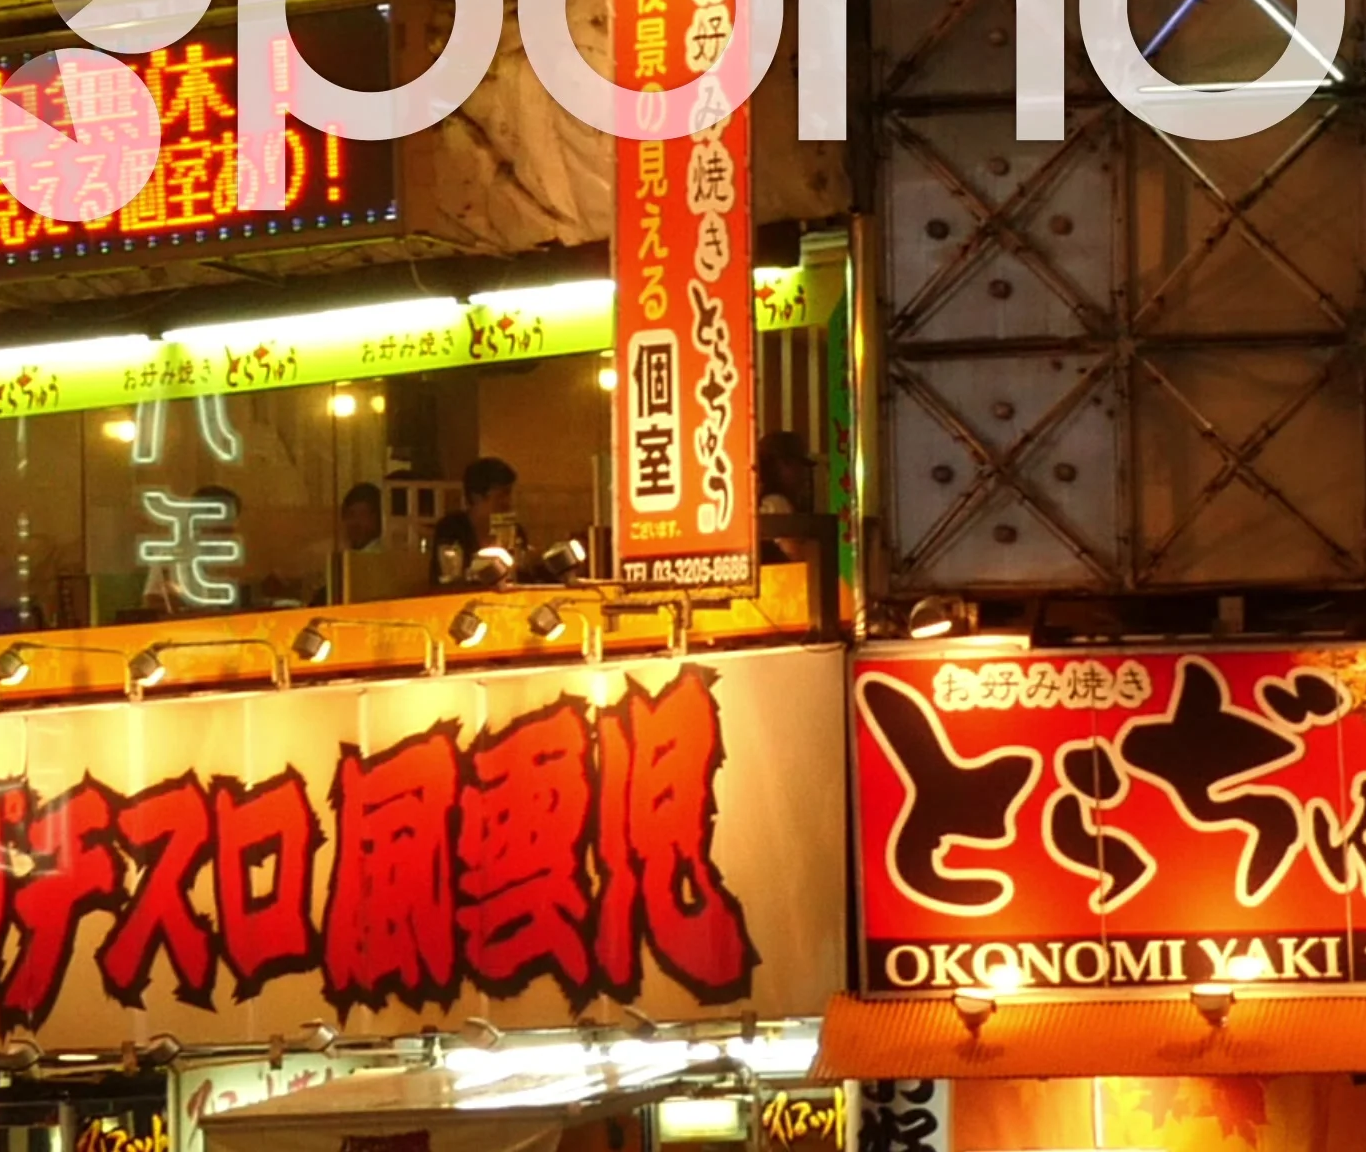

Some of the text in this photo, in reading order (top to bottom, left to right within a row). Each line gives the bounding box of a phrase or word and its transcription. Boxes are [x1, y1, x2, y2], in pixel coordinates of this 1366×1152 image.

[361, 328, 455, 363] お好み焼き
[123, 357, 212, 391] お好み焼き
[633, 342, 675, 497] 個室
[939, 665, 1150, 707] お好み焼き
[884, 936, 1343, 988] OKONOMI YAKI
